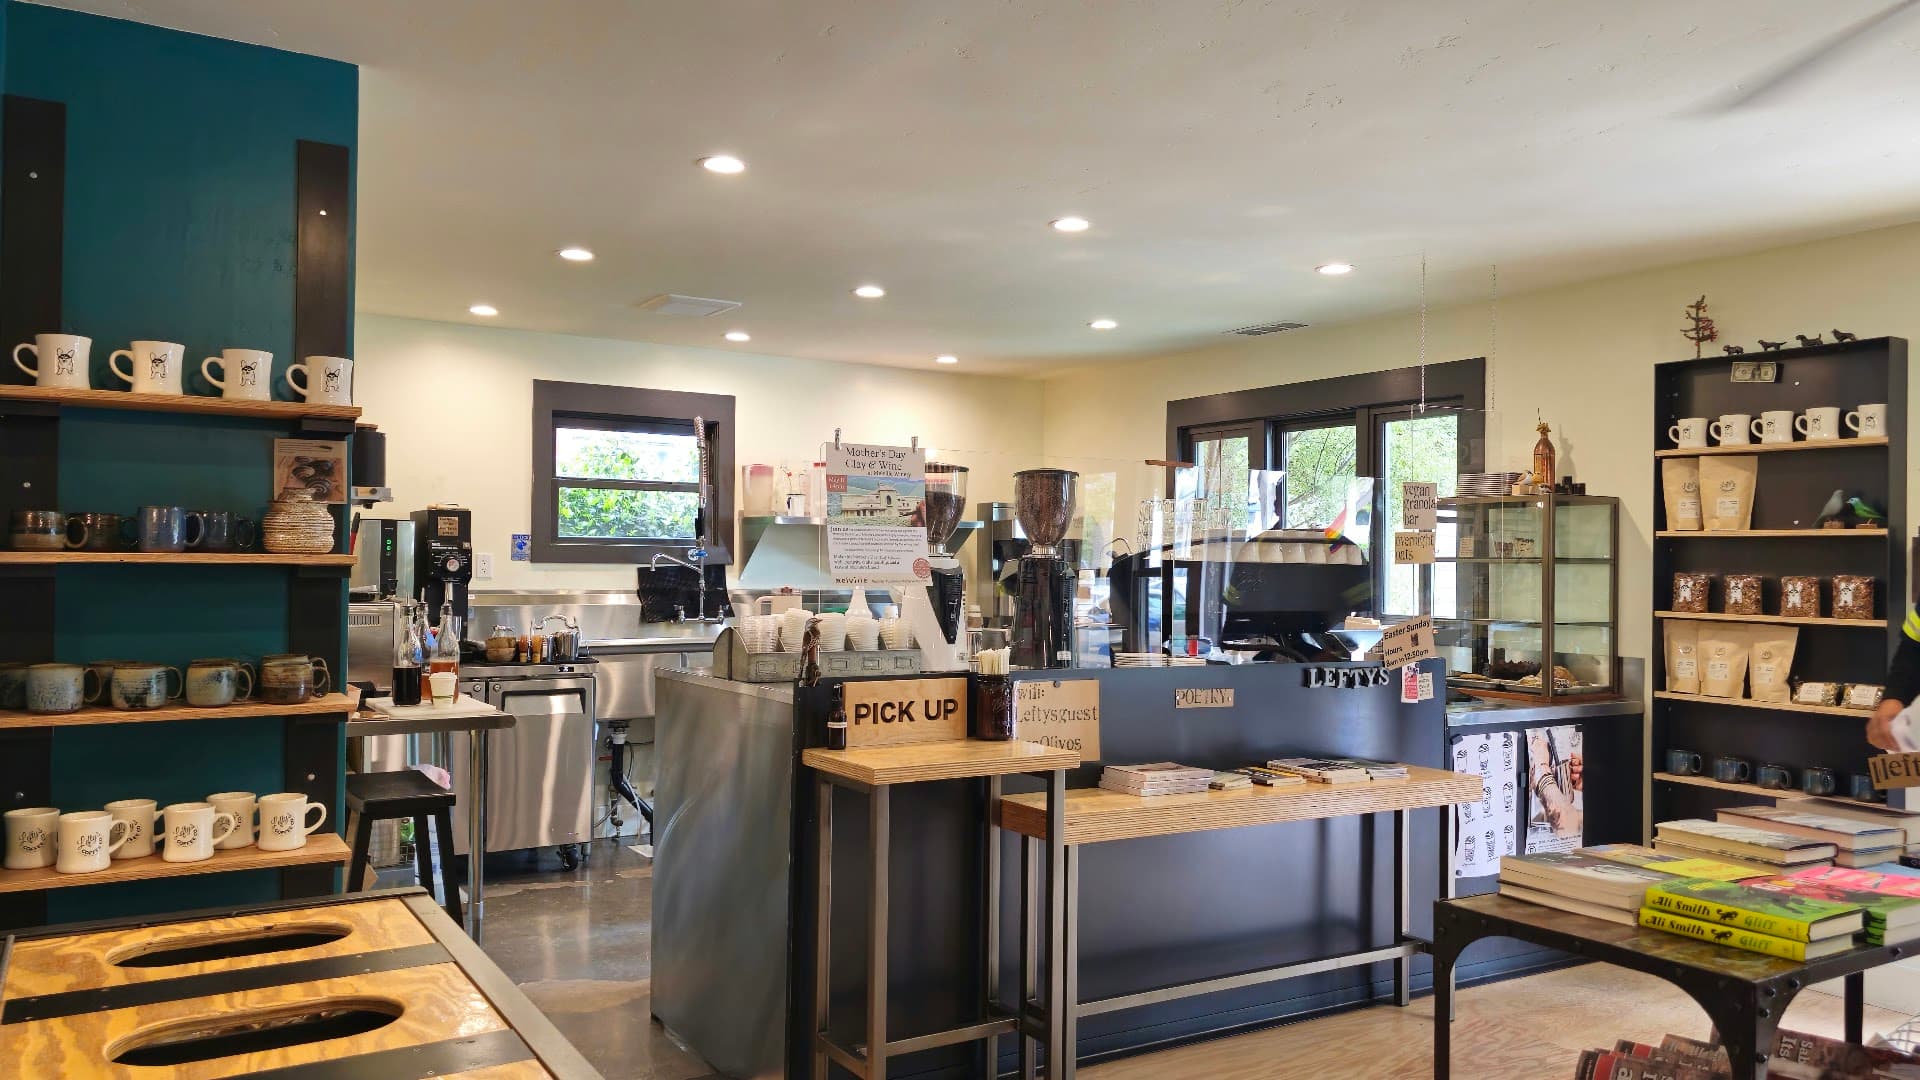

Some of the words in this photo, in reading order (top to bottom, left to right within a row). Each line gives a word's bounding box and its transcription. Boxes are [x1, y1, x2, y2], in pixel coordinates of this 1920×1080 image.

[846, 447, 886, 459] Mother's
[889, 449, 906, 462] Day
[845, 459, 866, 470] Clay
[868, 461, 877, 470] &
[879, 460, 902, 471] Wine
[1404, 485, 1430, 498] vegan
[1404, 497, 1436, 511] granola
[1404, 513, 1419, 526] bar
[1384, 627, 1405, 640] Easter
[1406, 619, 1431, 633] Sunday
[1385, 646, 1403, 657] Hours
[1306, 666, 1390, 689] LEFTYS
[854, 700, 916, 726] PICK
[924, 699, 959, 721] UP
[1652, 895, 1673, 908] Ali
[1674, 901, 1711, 917] Smith
[1743, 915, 1777, 930] Gliff
[1645, 914, 1666, 927] Ali
[1668, 919, 1705, 936] Smith
[1739, 935, 1773, 950] Gliff
